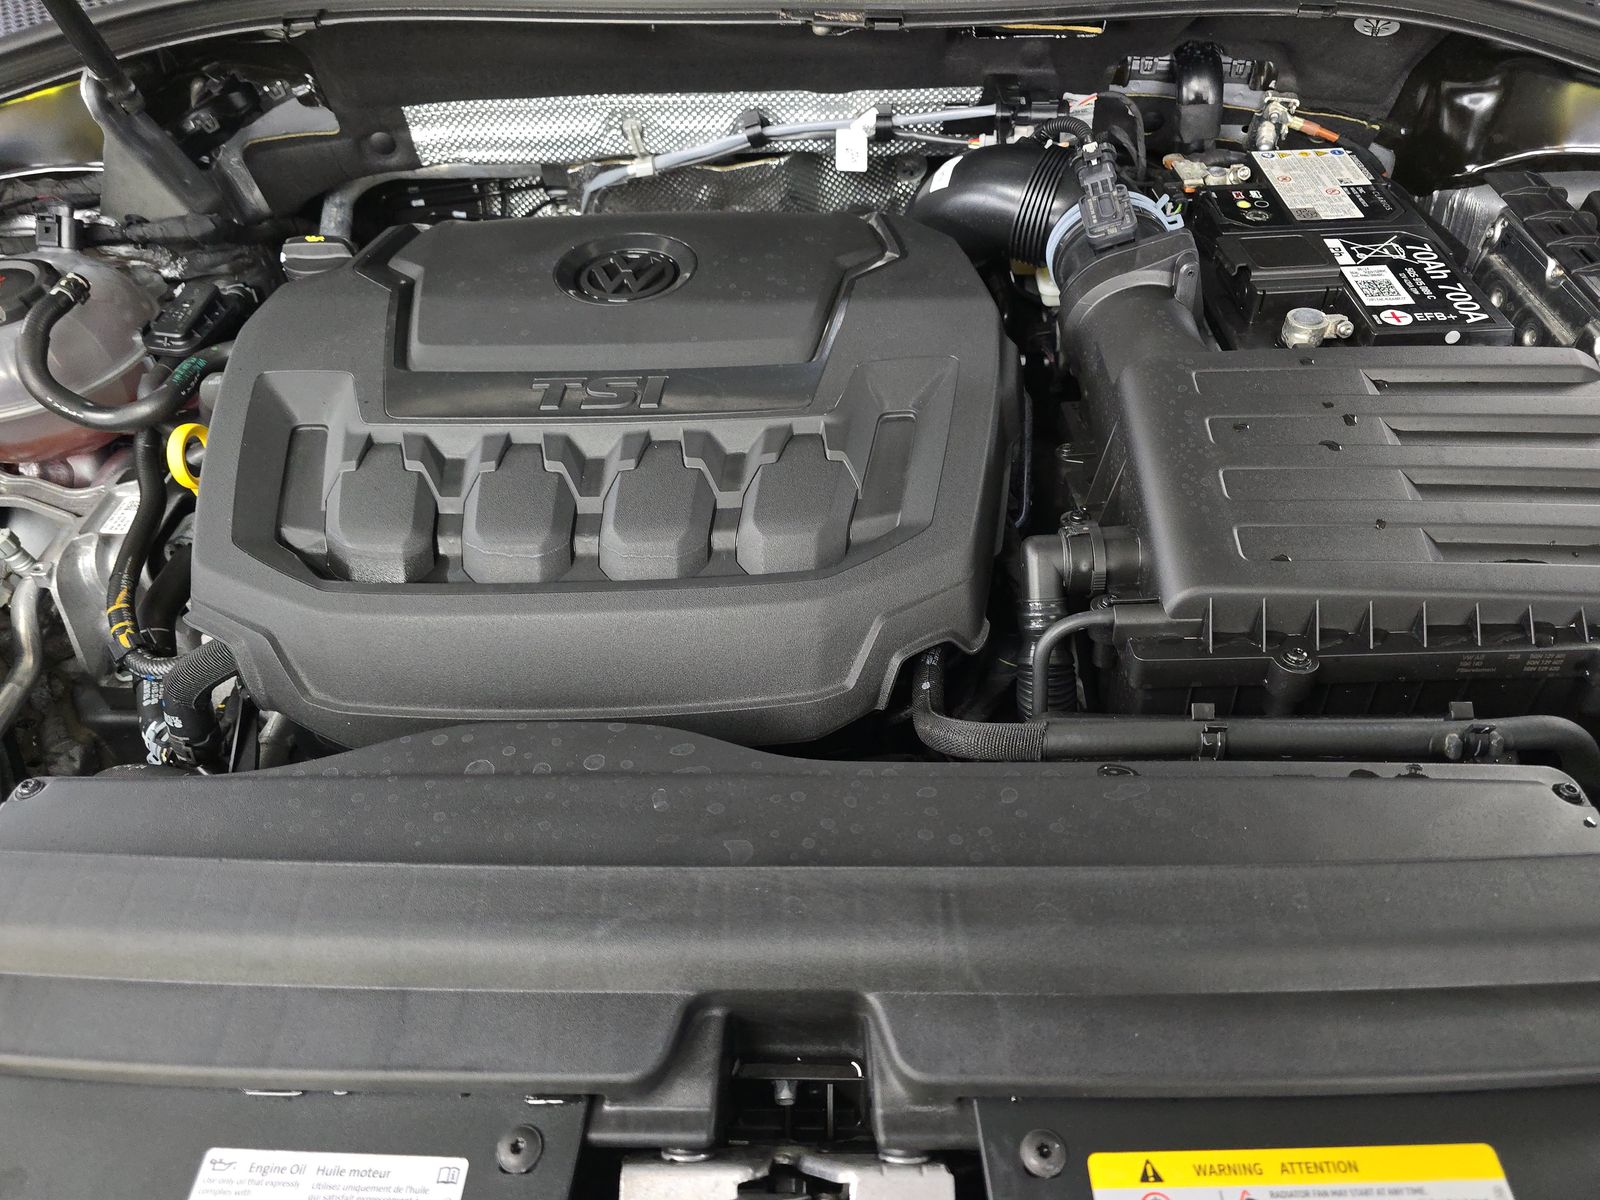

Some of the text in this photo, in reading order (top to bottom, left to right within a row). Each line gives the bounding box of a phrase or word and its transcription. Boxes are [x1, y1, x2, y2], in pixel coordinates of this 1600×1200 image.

[1372, 190, 1393, 211] CLARIOS
[1406, 243, 1489, 324] 70Ah 700A
[1414, 312, 1457, 321] EFB+
[532, 375, 669, 411] TSI
[248, 1162, 307, 1177] Engine Oil
[316, 1165, 391, 1179] Huile moteur
[1193, 1160, 1359, 1176] WARNING ATTENTION
[218, 1178, 234, 1186] only
[247, 1178, 264, 1186] that
[264, 1179, 301, 1189] expressly
[311, 1182, 430, 1195] Utilisez uniquement de l'huile
[234, 1188, 252, 1196] with
[1269, 1190, 1311, 1199] RADIATOR
[1312, 1190, 1330, 1198] FAN
[1331, 1190, 1348, 1198] MAY
[1349, 1189, 1375, 1198] START
[1376, 1188, 1386, 1196] AT
[1388, 1188, 1404, 1196] ANY
